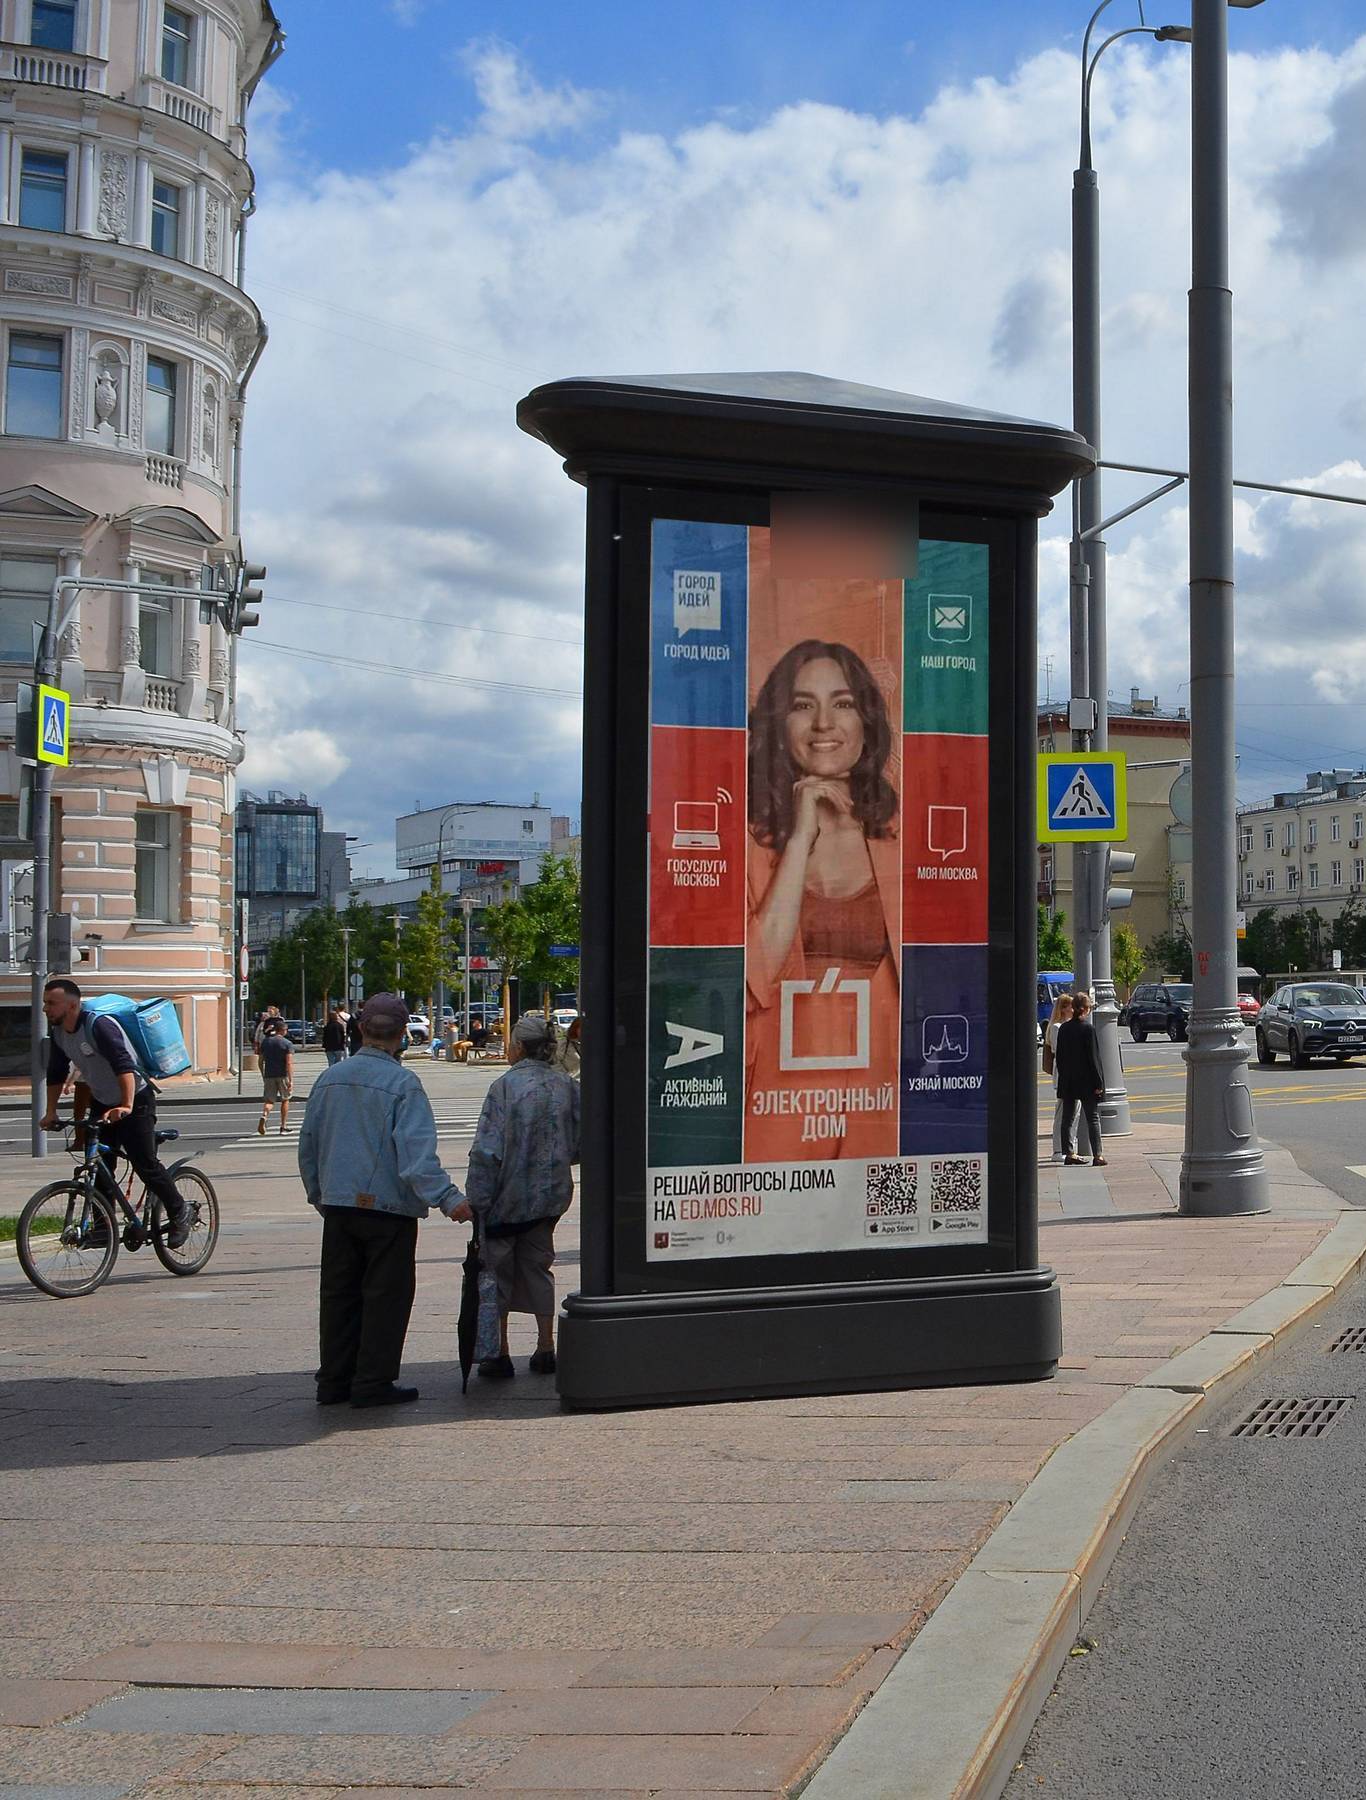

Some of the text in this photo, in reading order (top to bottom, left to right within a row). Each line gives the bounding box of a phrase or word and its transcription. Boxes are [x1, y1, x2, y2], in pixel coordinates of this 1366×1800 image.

[678, 574, 715, 591] ГОРОД
[678, 591, 710, 607] ИДЕЙ
[664, 644, 730, 660] ГОРОД ИДЕЙ
[921, 656, 976, 672] НАШ ГОРОД
[667, 859, 727, 874] ГОСУСЛУГИ
[918, 867, 977, 880] МОЯ МОСКВА
[674, 874, 719, 887] МОСКВЫ
[665, 1077, 723, 1093] АКТИВНЫЙ
[909, 1074, 982, 1091] УЗНАЙ МОСКВУ
[660, 1091, 727, 1108] ГРАЖДАНИН
[753, 1083, 894, 1115] ЭЛЕКТРОННЫЙ
[801, 1115, 846, 1142] ДОМ
[654, 1169, 835, 1196] РЕШАЙ ВОПРОСЫ ДОМА
[654, 1197, 762, 1221] НА ED.MOS.RU
[896, 1224, 914, 1232] Store
[945, 1221, 979, 1229] Google Play
